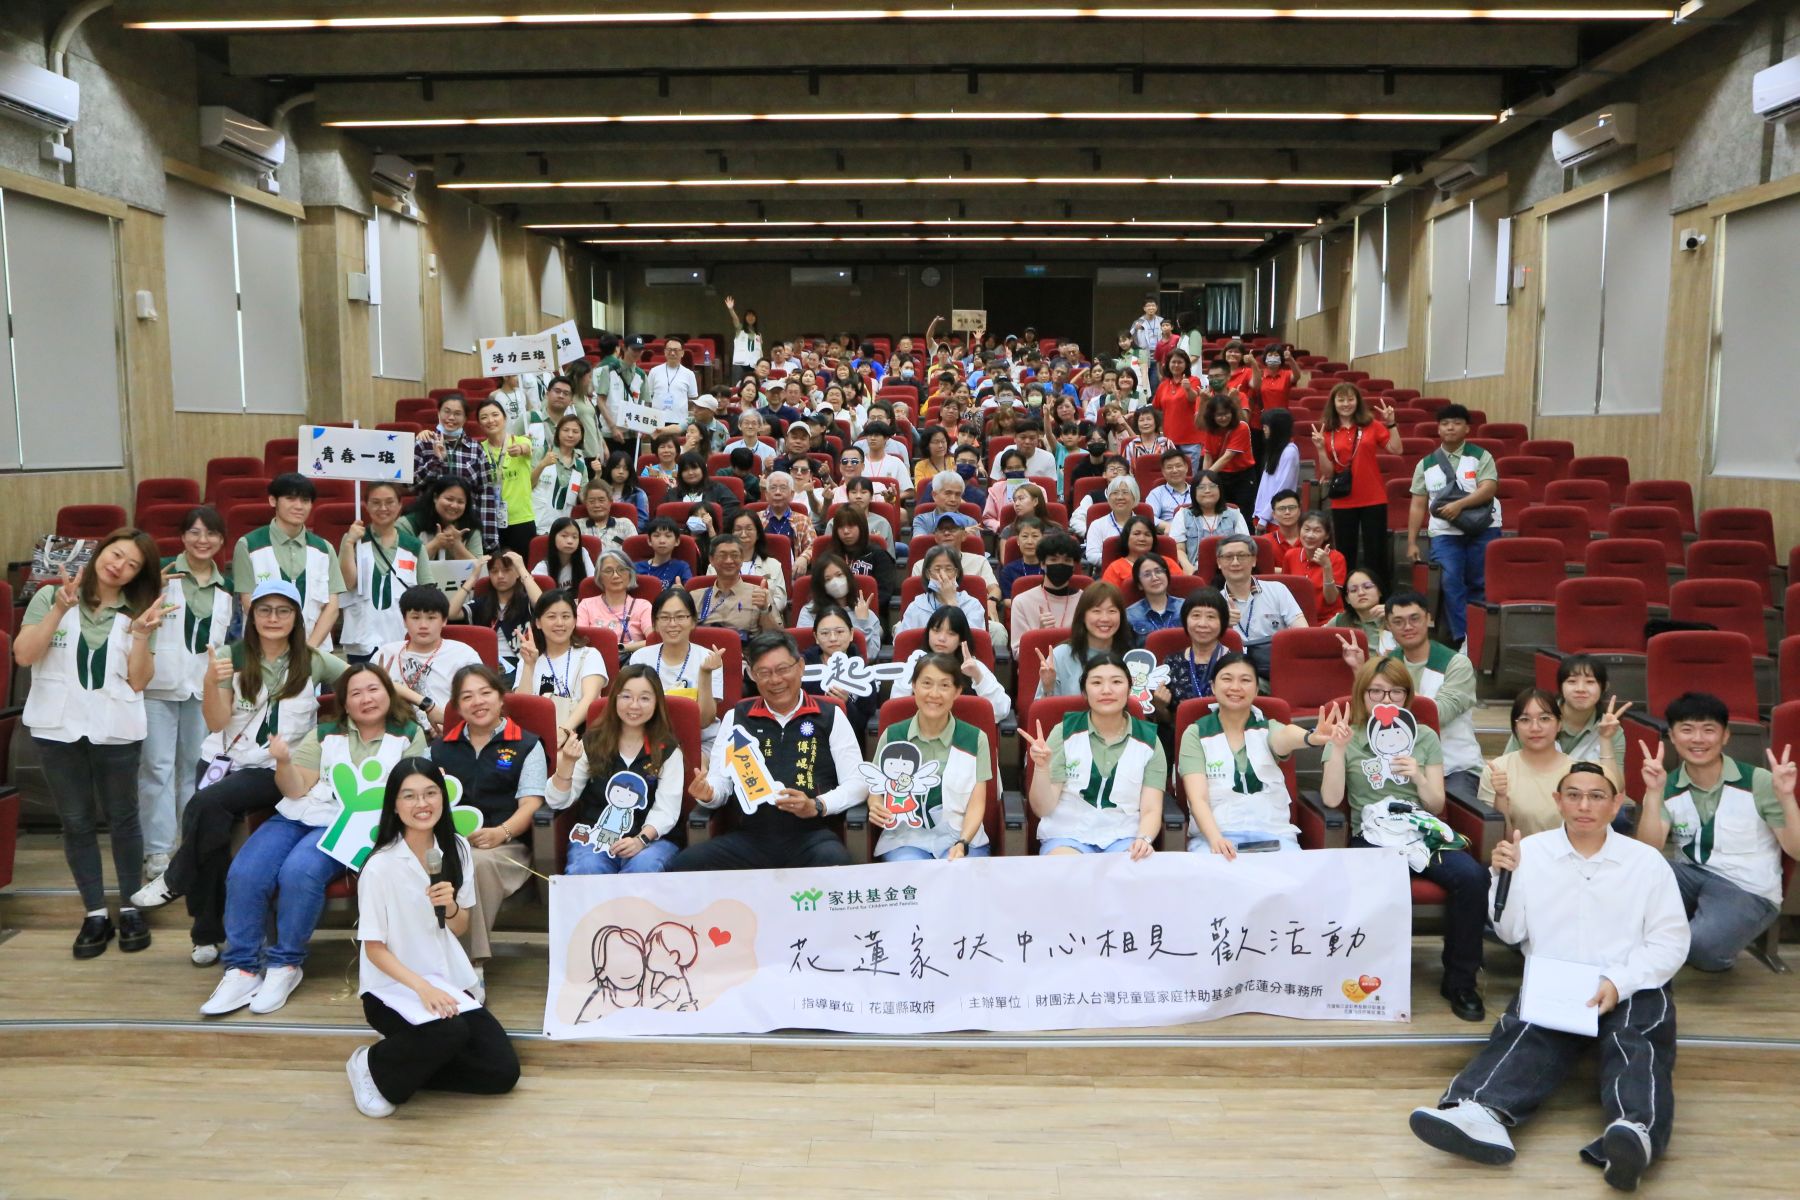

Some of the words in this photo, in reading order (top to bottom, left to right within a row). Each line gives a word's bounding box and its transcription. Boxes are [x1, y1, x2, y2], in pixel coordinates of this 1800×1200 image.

[492, 350, 546, 364] 活力三班
[321, 446, 396, 464] 青春一班
[803, 655, 923, 692] 一起一
[764, 738, 773, 757] 主任
[828, 885, 918, 906] 家扶基金會
[789, 917, 1367, 979] 花蓮家扶中心相見歡活動
[968, 996, 1021, 1009] 主辦單位
[1035, 979, 1323, 1007] 財團法人台灣兒童暨家庭扶助基金會花蓮分事務所
[801, 997, 855, 1013] 指導單位
[868, 1000, 935, 1015] 花蓮縣政府
